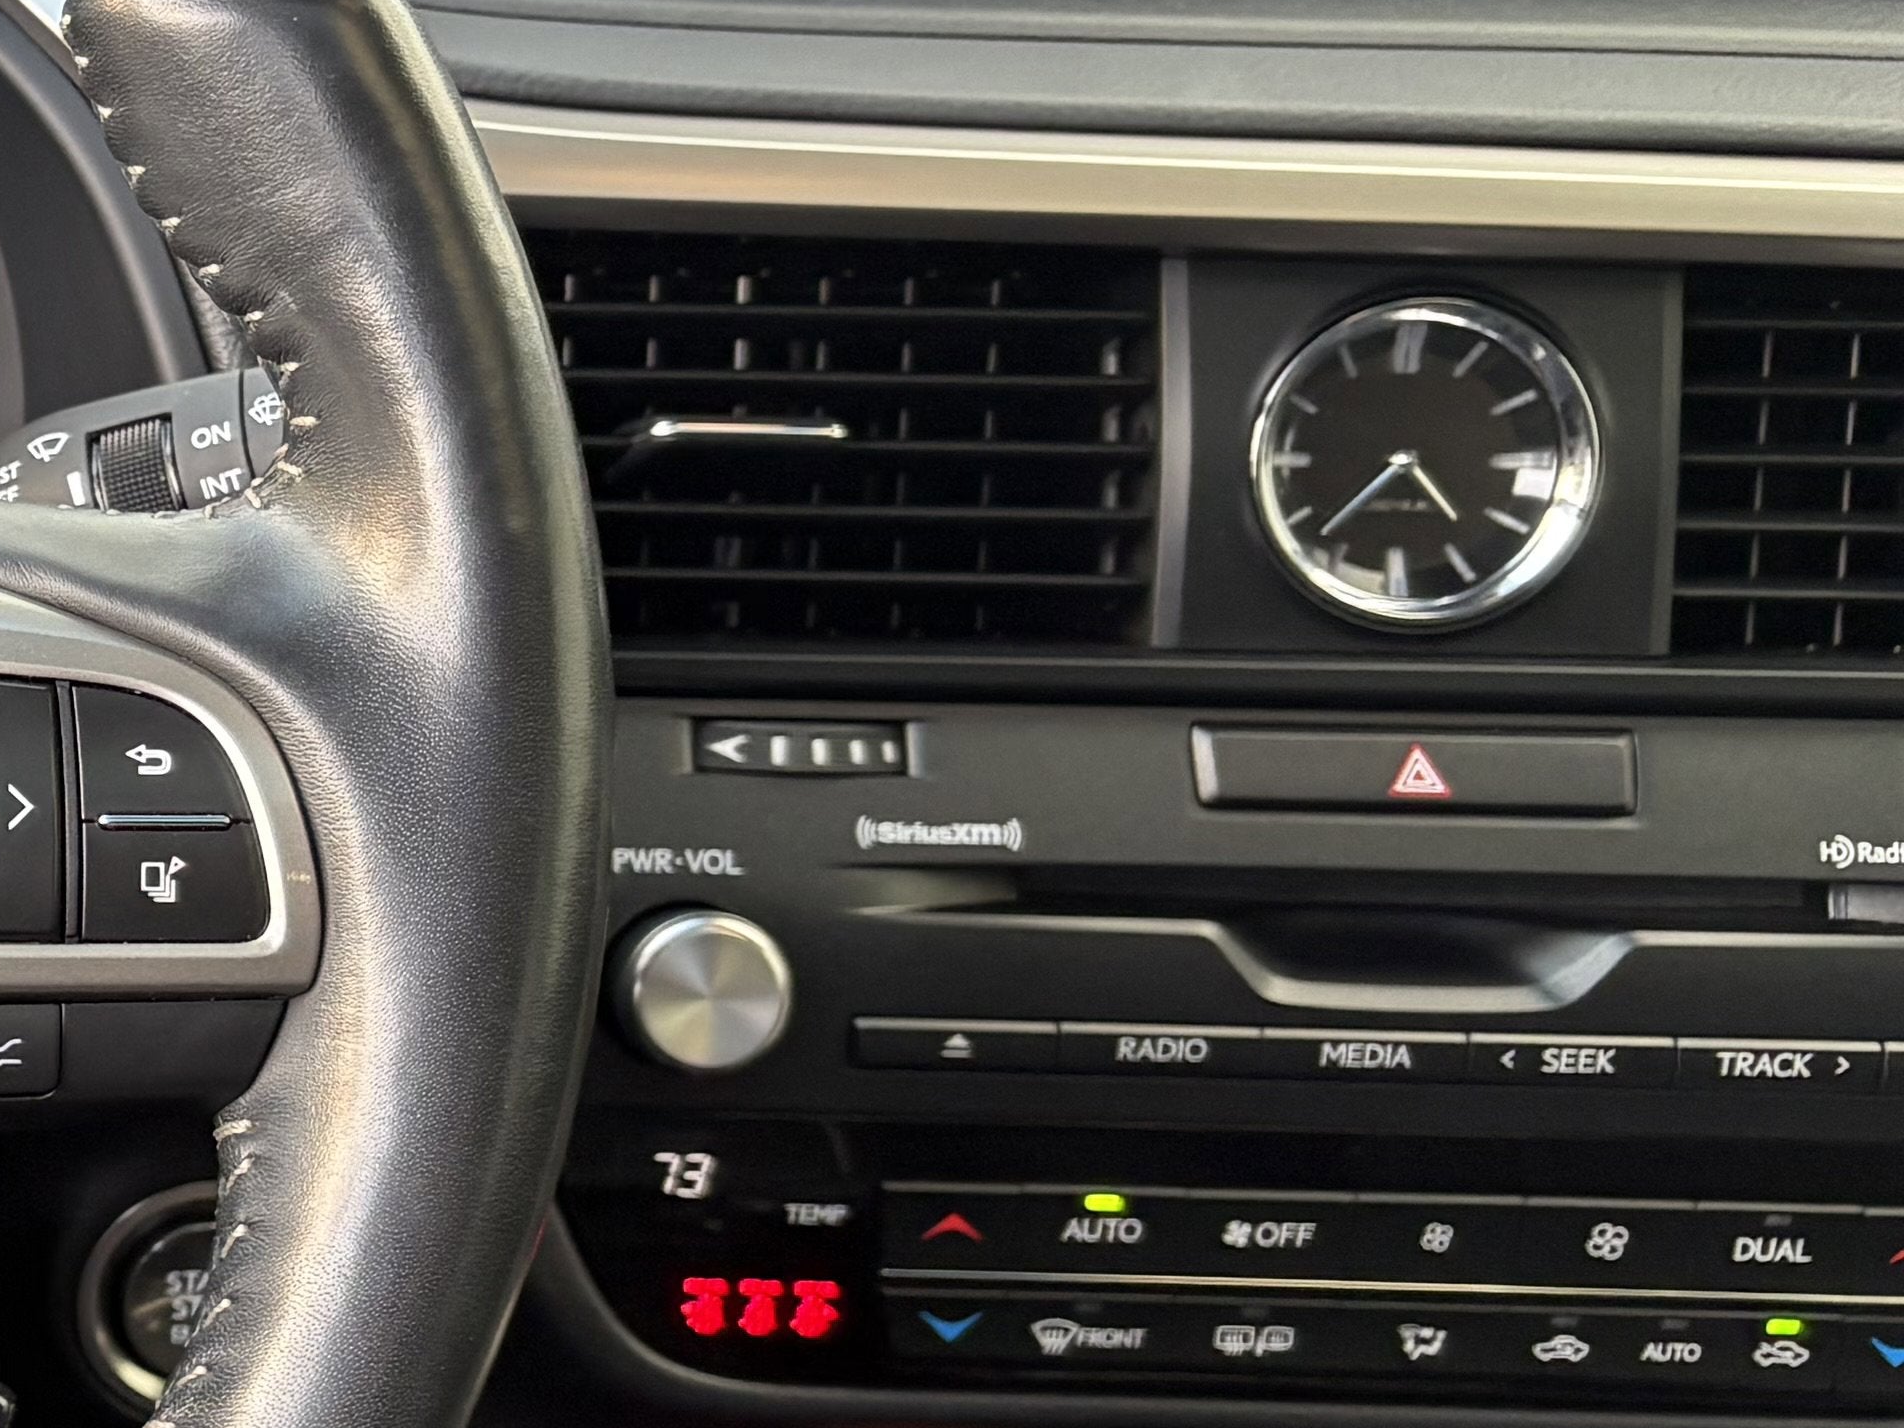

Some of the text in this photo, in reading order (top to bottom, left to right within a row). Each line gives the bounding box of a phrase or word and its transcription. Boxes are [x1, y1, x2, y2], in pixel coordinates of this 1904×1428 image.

[192, 422, 231, 449] ON
[200, 468, 243, 500] INT
[1116, 1036, 1209, 1063] RADIO
[1319, 1042, 1412, 1070] MEDIA
[1540, 1047, 1616, 1075] SEEK
[1716, 1051, 1814, 1080] TRACK
[653, 1152, 719, 1199] 73
[784, 1203, 850, 1227] TEMP
[1060, 1218, 1143, 1244] AUTO
[1255, 1222, 1317, 1248] OFF
[1732, 1237, 1812, 1264] DUAL
[1075, 1327, 1149, 1350] FRONT
[1640, 1341, 1703, 1364] AUTO
